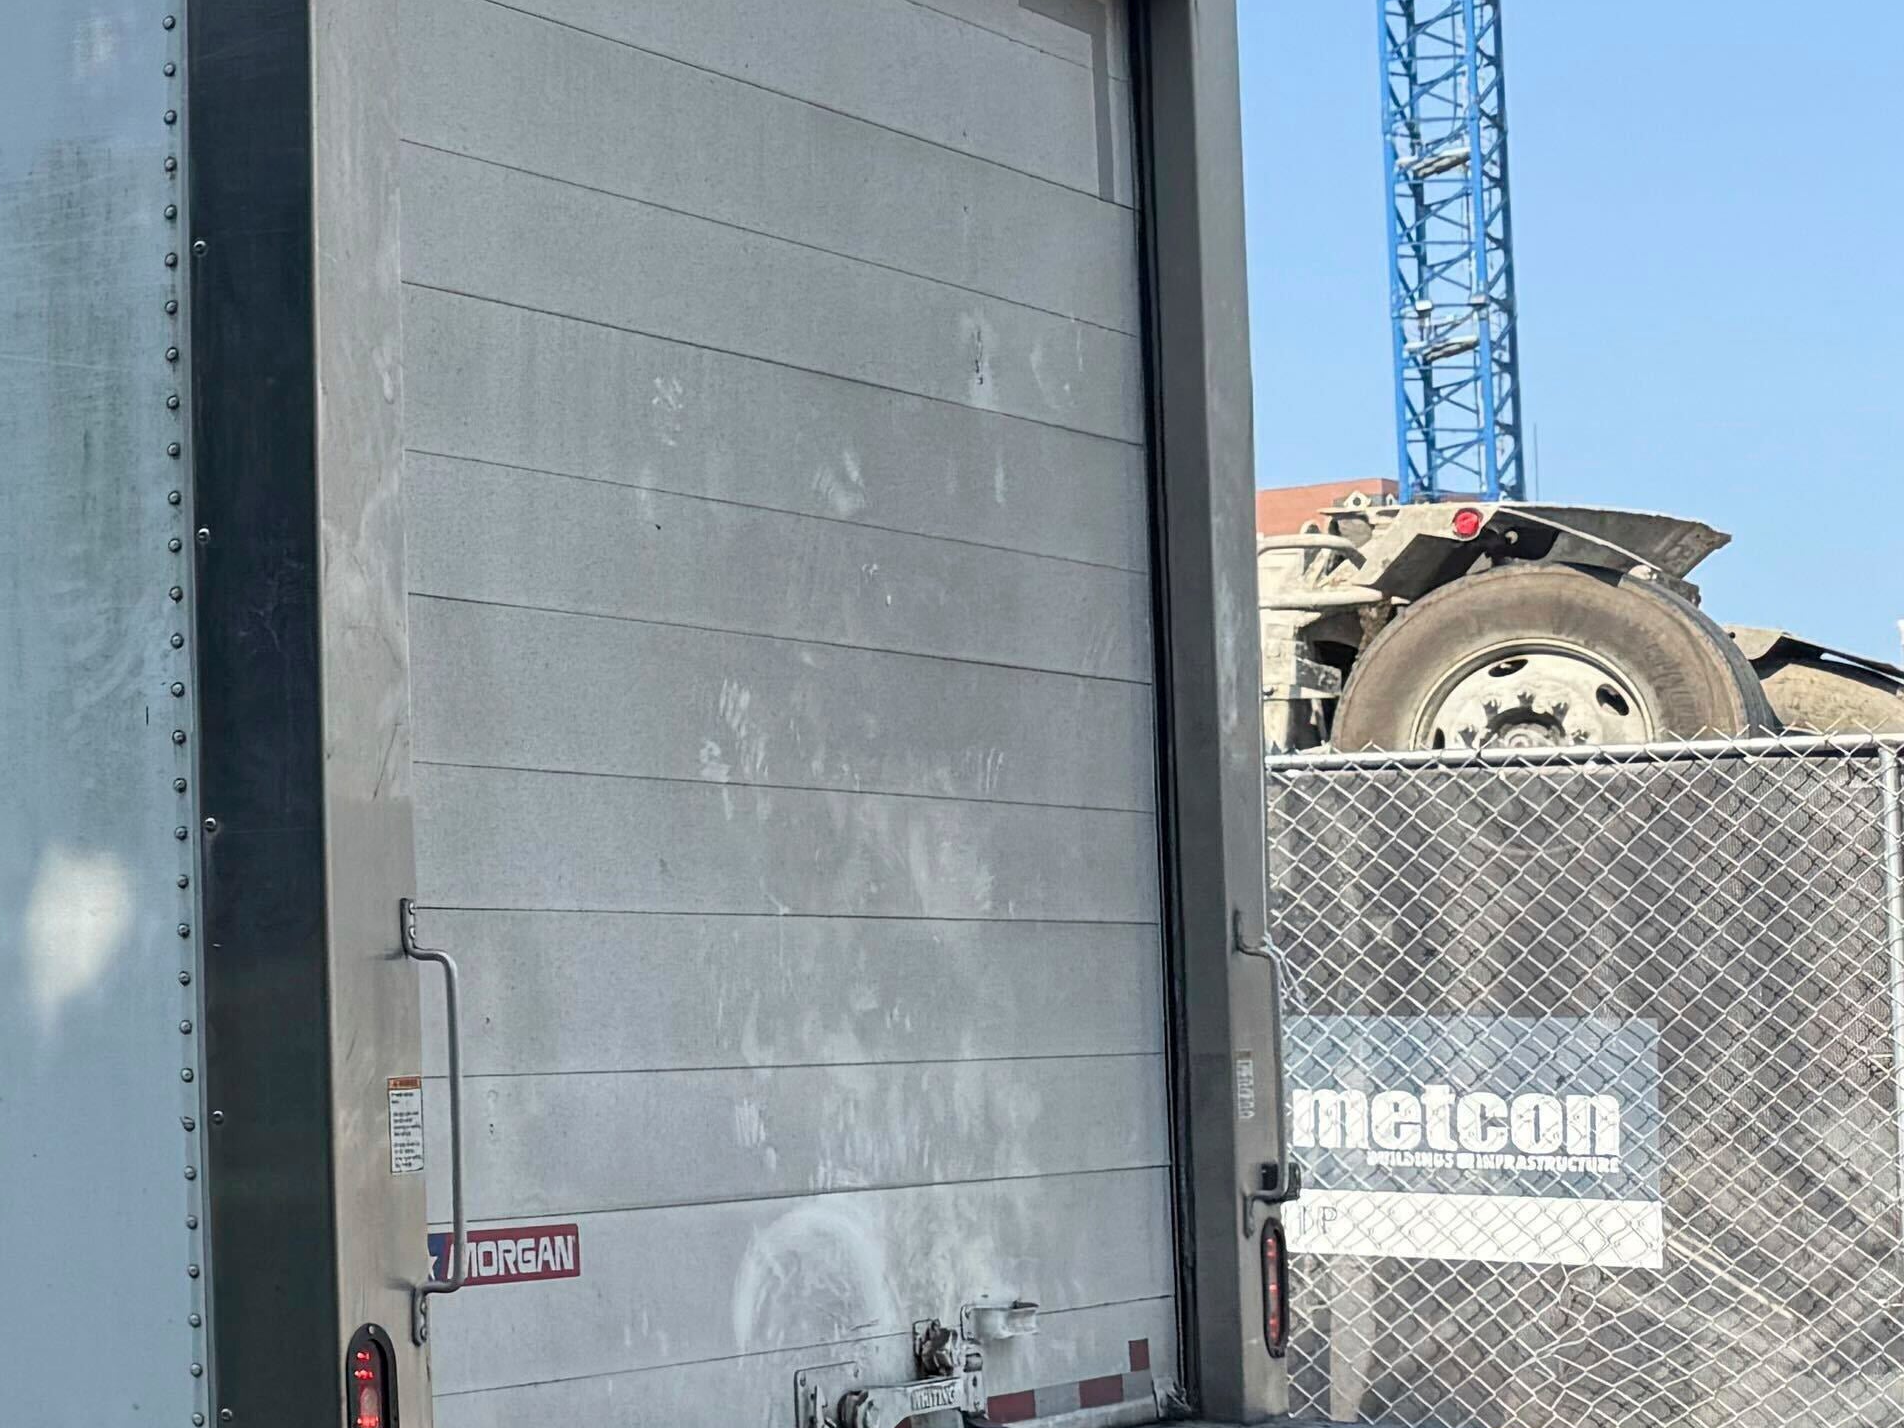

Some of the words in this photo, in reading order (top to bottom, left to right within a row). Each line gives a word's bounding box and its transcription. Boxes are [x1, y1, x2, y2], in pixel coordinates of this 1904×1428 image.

[1292, 1083, 1621, 1156] metcon
[1366, 1149, 1455, 1170] BUILDINGS
[1473, 1152, 1620, 1174] INFRASTRUCTURE
[446, 1235, 576, 1280] MORGAN
